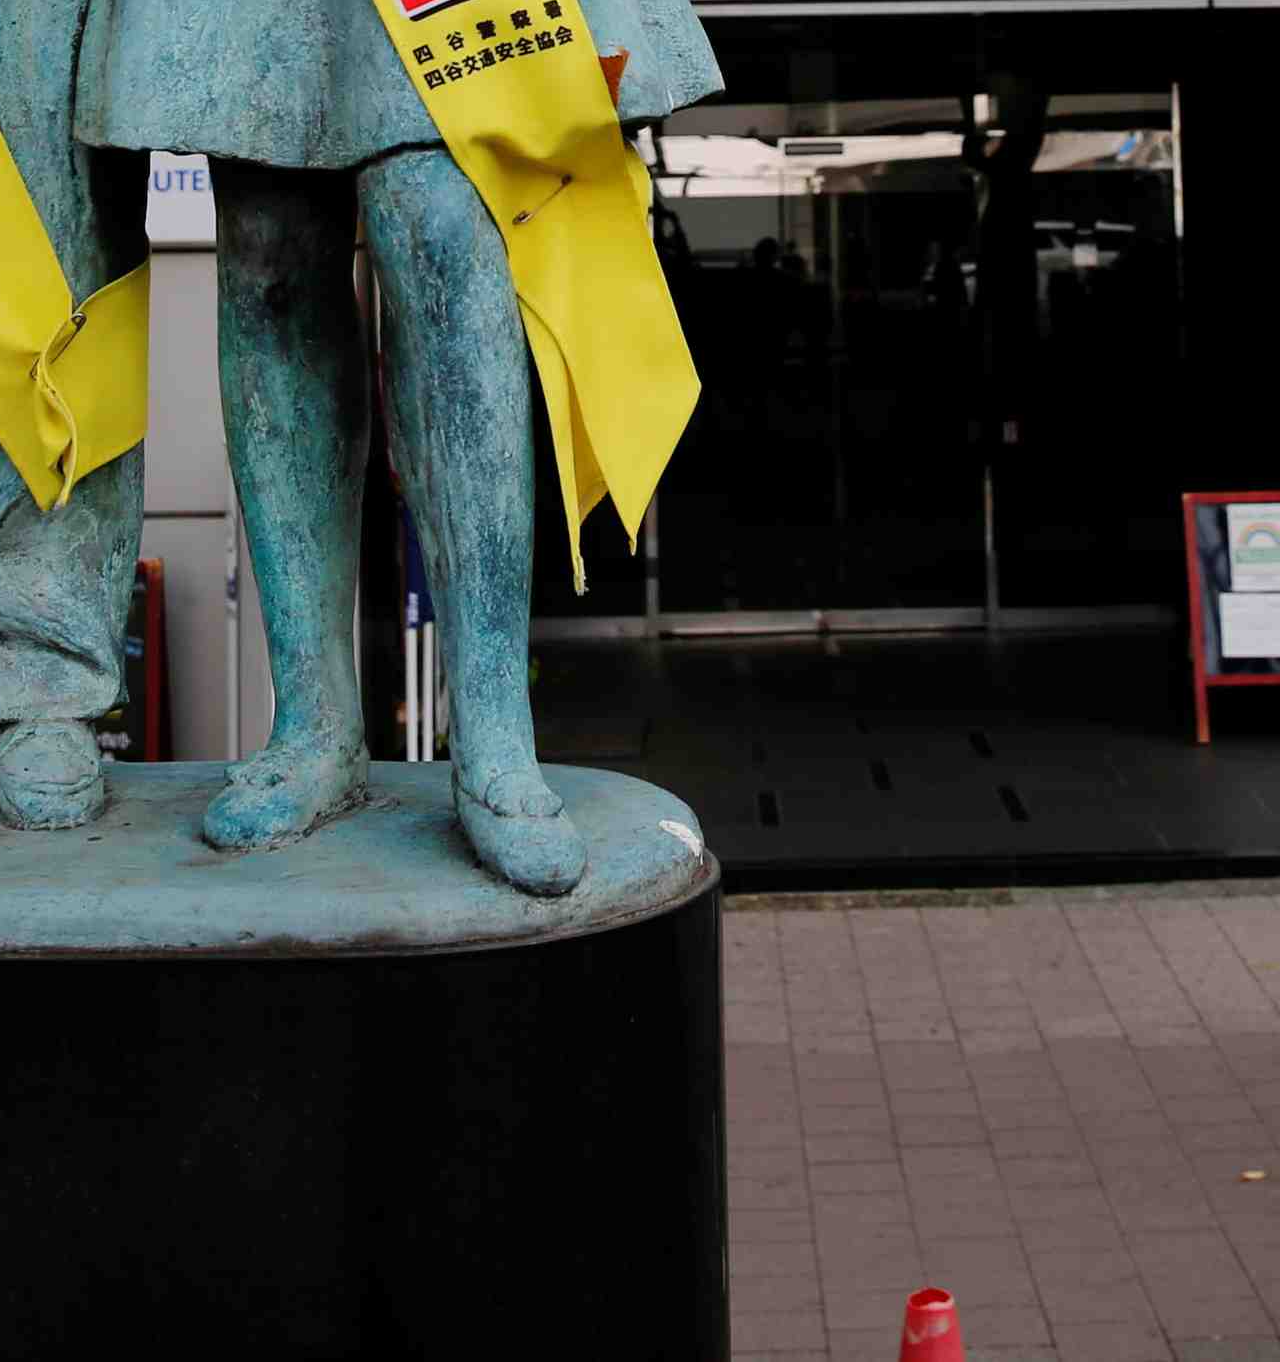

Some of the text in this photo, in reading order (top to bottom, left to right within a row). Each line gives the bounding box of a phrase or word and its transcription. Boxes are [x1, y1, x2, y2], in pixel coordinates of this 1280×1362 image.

[412, 0, 562, 65] 四谷警察署
[424, 25, 574, 90] 四谷交通安全協会
[154, 169, 212, 191] UTE
